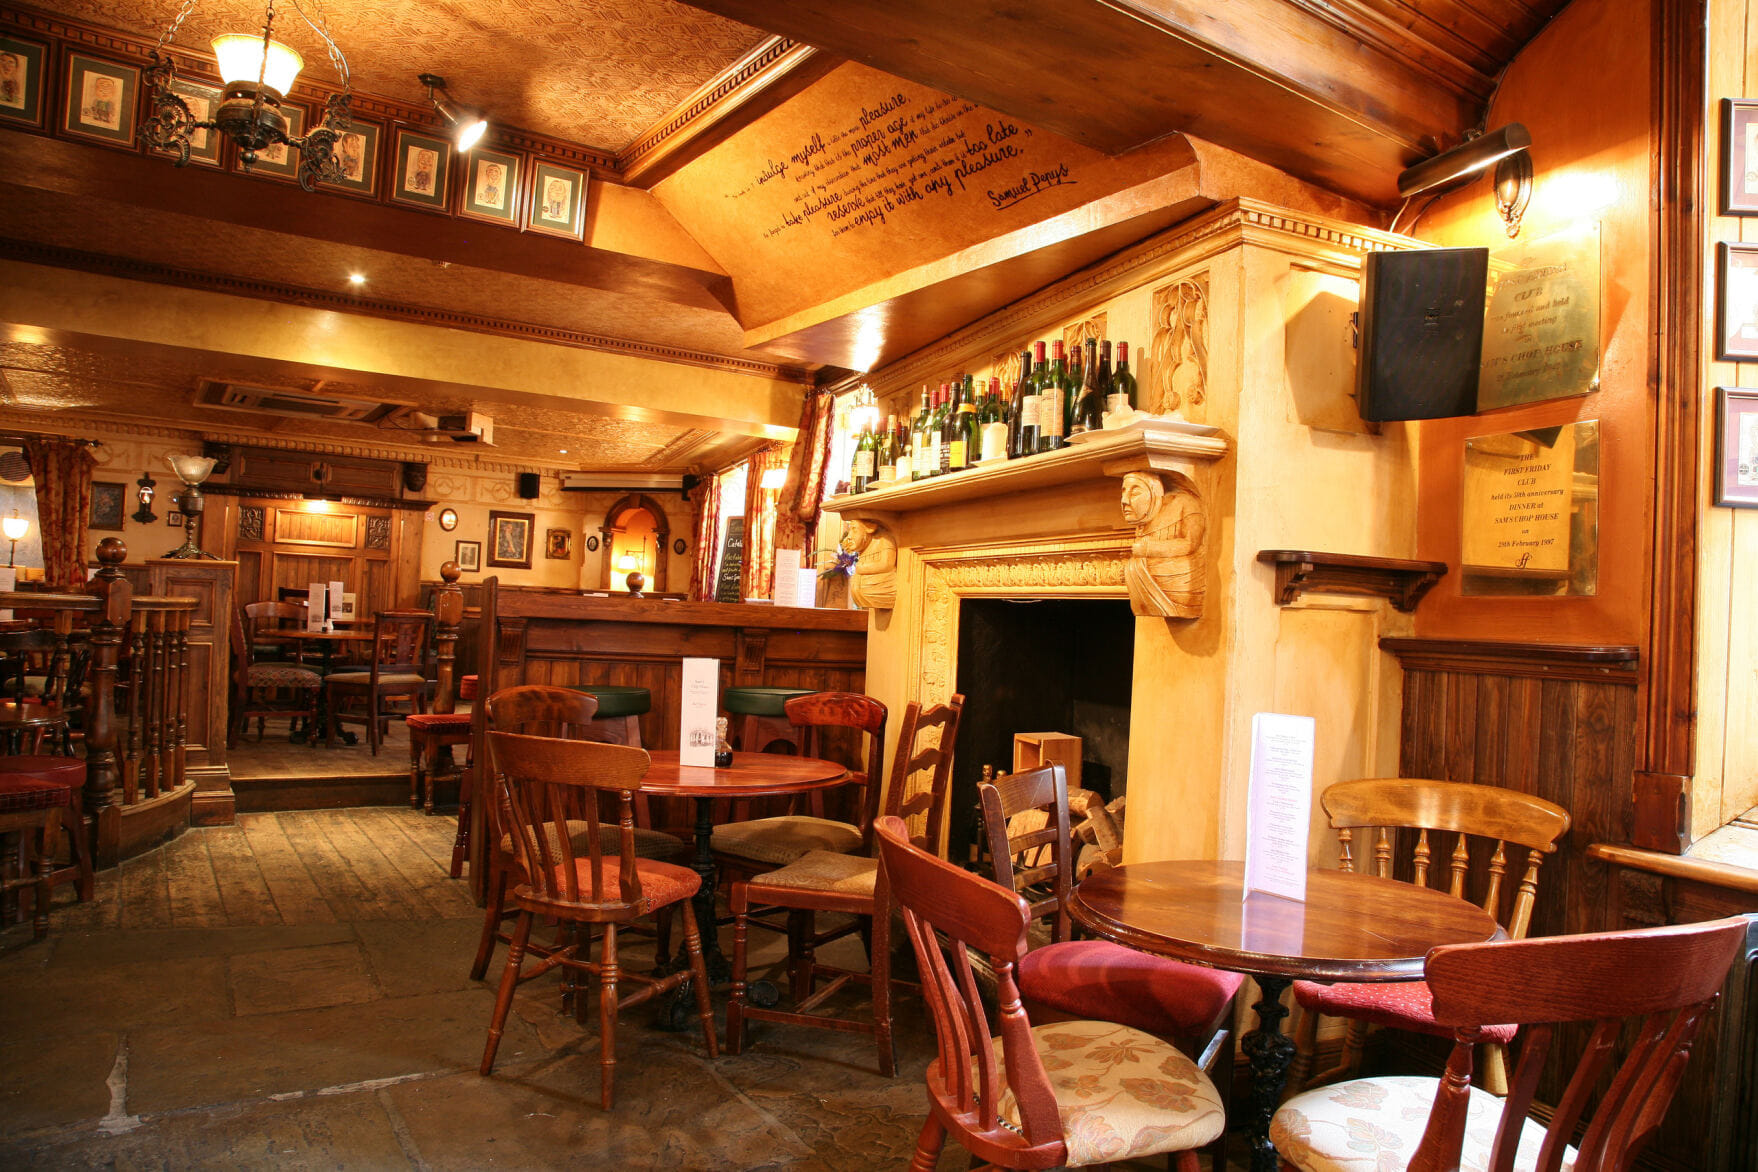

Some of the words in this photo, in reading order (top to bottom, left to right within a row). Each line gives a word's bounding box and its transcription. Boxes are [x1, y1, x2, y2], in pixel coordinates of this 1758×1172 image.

[851, 129, 886, 157] proper
[887, 117, 908, 135] age
[863, 141, 892, 166] most
[892, 128, 918, 149] men
[756, 160, 788, 184] indulge
[791, 133, 826, 166] myself
[826, 194, 866, 221] reserve
[964, 138, 989, 156] too
[986, 120, 1019, 144] late
[854, 205, 886, 226] enjoy
[884, 196, 895, 213] it
[896, 185, 924, 206] with
[924, 175, 953, 197] any
[954, 144, 1024, 191] pleasure.
[987, 177, 1032, 207] Samuel
[1028, 161, 1069, 191] Pepys
[783, 210, 804, 226] take
[803, 192, 842, 223] pleasure
[1503, 466, 1524, 476] FIRST
[1524, 463, 1552, 474] FRIDAY
[1520, 453, 1535, 462] THE
[1517, 477, 1537, 487] CLUB
[1509, 502, 1537, 511] DINNER
[1534, 512, 1560, 522] HOUSE
